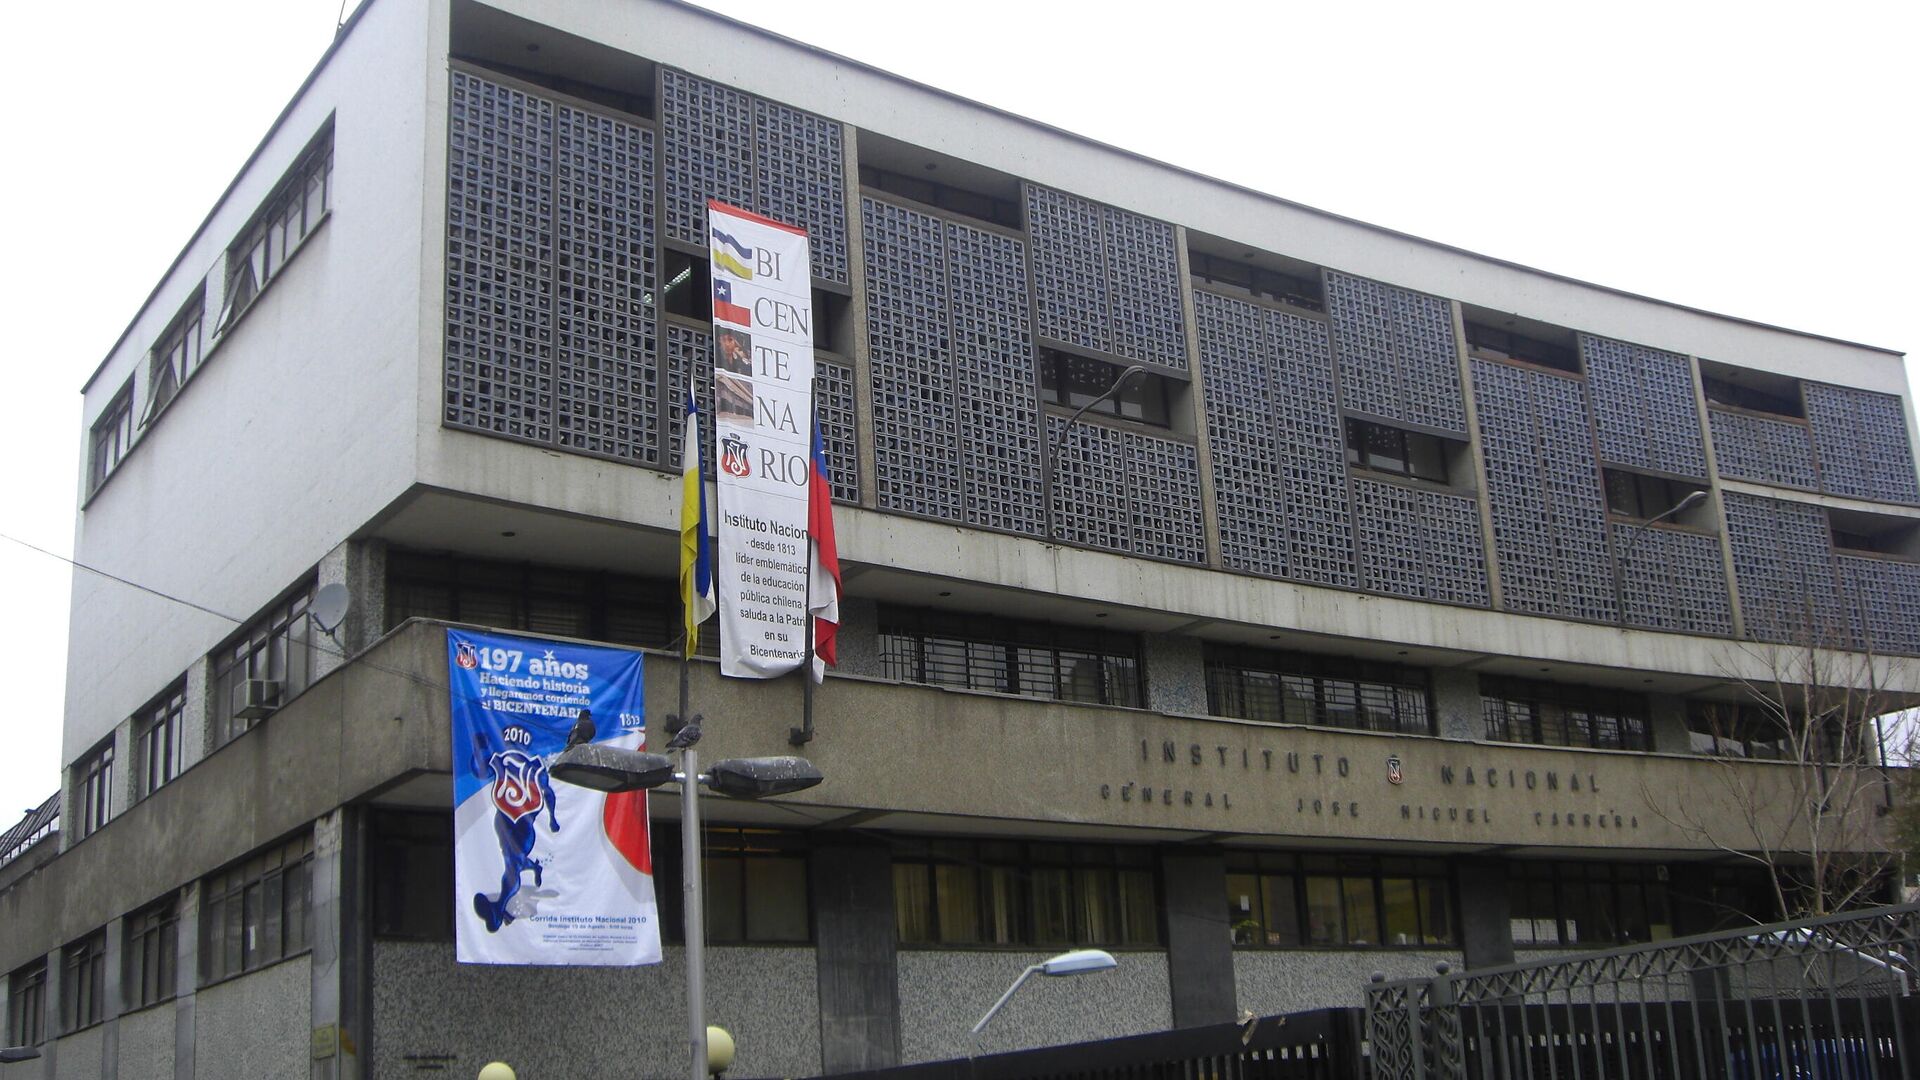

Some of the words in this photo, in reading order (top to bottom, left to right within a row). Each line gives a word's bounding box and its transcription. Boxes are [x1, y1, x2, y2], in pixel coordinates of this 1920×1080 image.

[755, 247, 783, 281] BI
[754, 297, 809, 336] CEN
[755, 346, 791, 381] TE
[756, 396, 799, 435] NA
[759, 448, 809, 486] RIO
[724, 509, 767, 532] Instituto
[770, 520, 809, 540] Nacion
[750, 538, 775, 552] desde
[778, 543, 796, 555] 1813
[755, 558, 808, 575] emblemático
[741, 571, 751, 582] de
[753, 573, 760, 584] la
[762, 576, 805, 592] educación
[740, 590, 770, 602] pública
[772, 595, 802, 609] chilena
[740, 608, 767, 621] saluda
[769, 614, 775, 622] a
[777, 613, 784, 624] la
[786, 614, 806, 626] Patri
[764, 632, 775, 640] en
[777, 633, 788, 642] su
[479, 647, 523, 672] 197
[480, 672, 540, 688] Haciendo
[543, 678, 590, 694] historia
[480, 687, 487, 697] y
[489, 686, 544, 701] llegaremos
[545, 694, 590, 705] corriendo
[503, 728, 531, 745] 2010
[1142, 739, 1349, 778] INSTITUTO
[1441, 764, 1600, 793] NACIONAL
[1401, 804, 1491, 824] MIGUEL
[560, 915, 593, 923] Instituto
